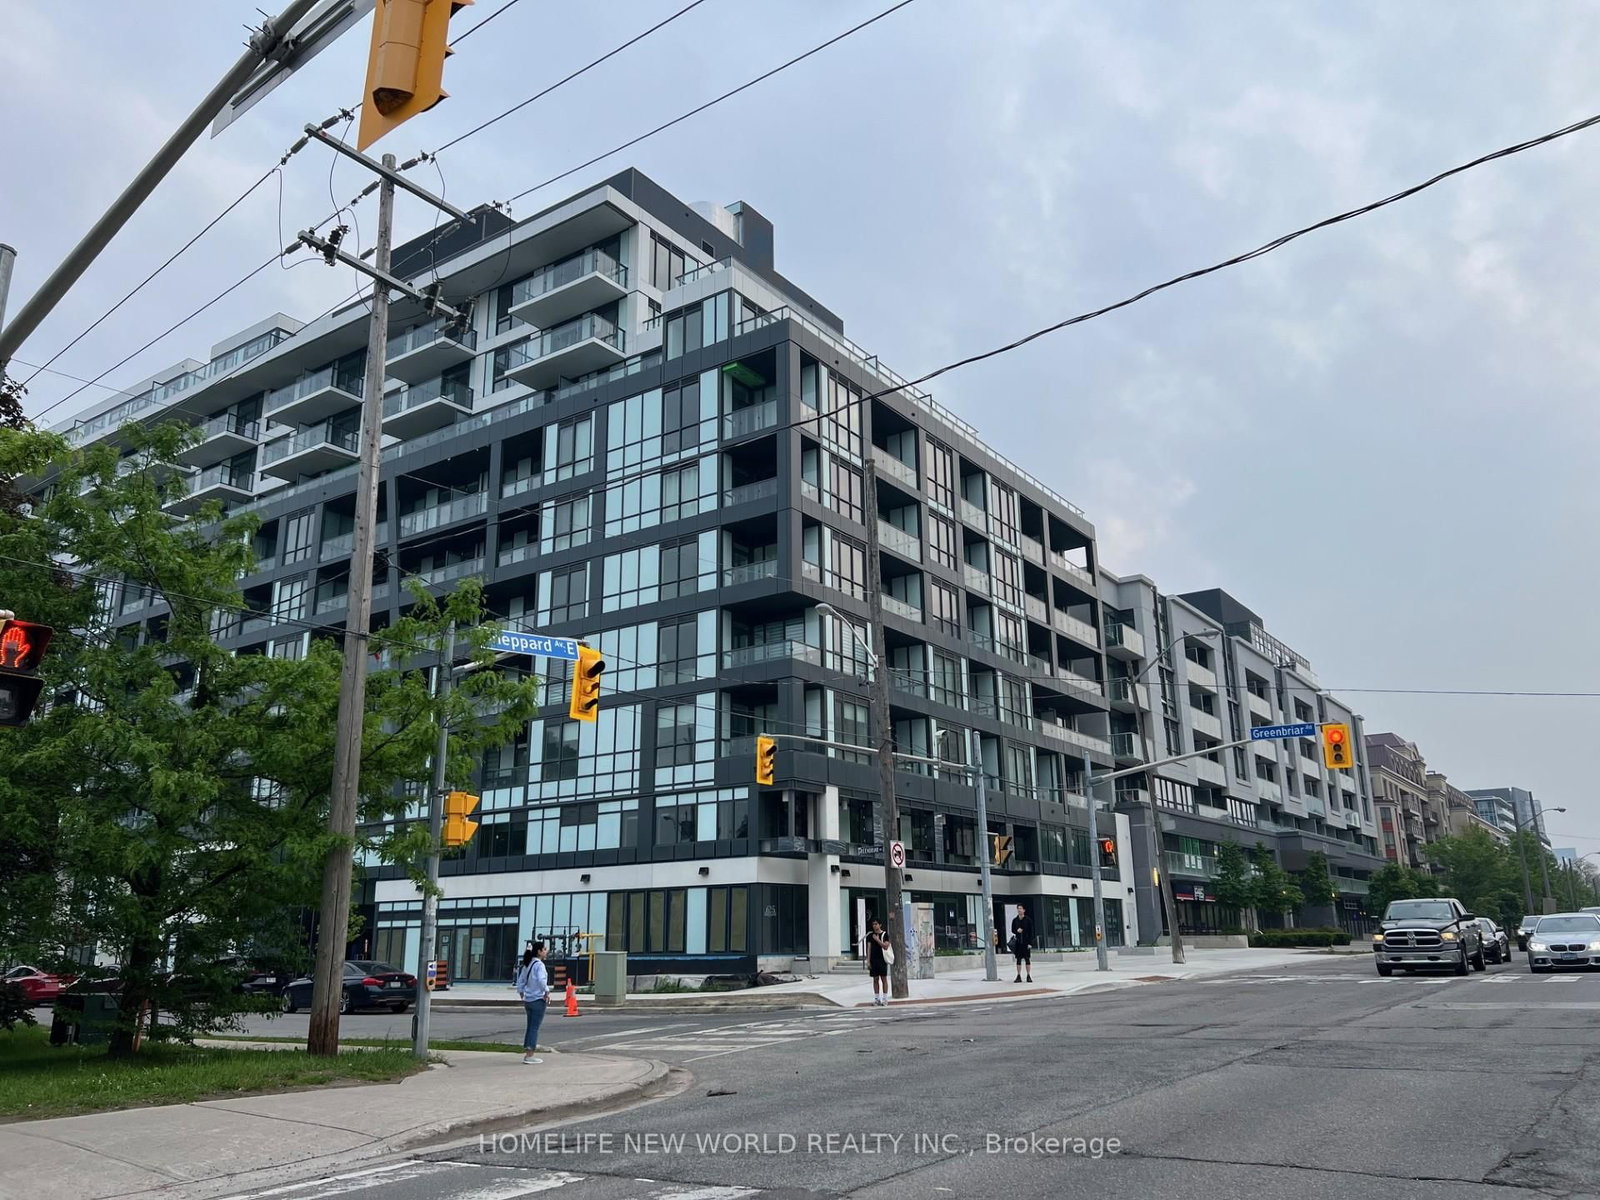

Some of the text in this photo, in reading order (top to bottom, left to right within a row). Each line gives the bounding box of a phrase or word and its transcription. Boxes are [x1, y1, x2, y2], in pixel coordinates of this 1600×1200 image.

[498, 635, 552, 652] eppard
[567, 641, 575, 655] E
[1252, 727, 1304, 738] Greenbriar
